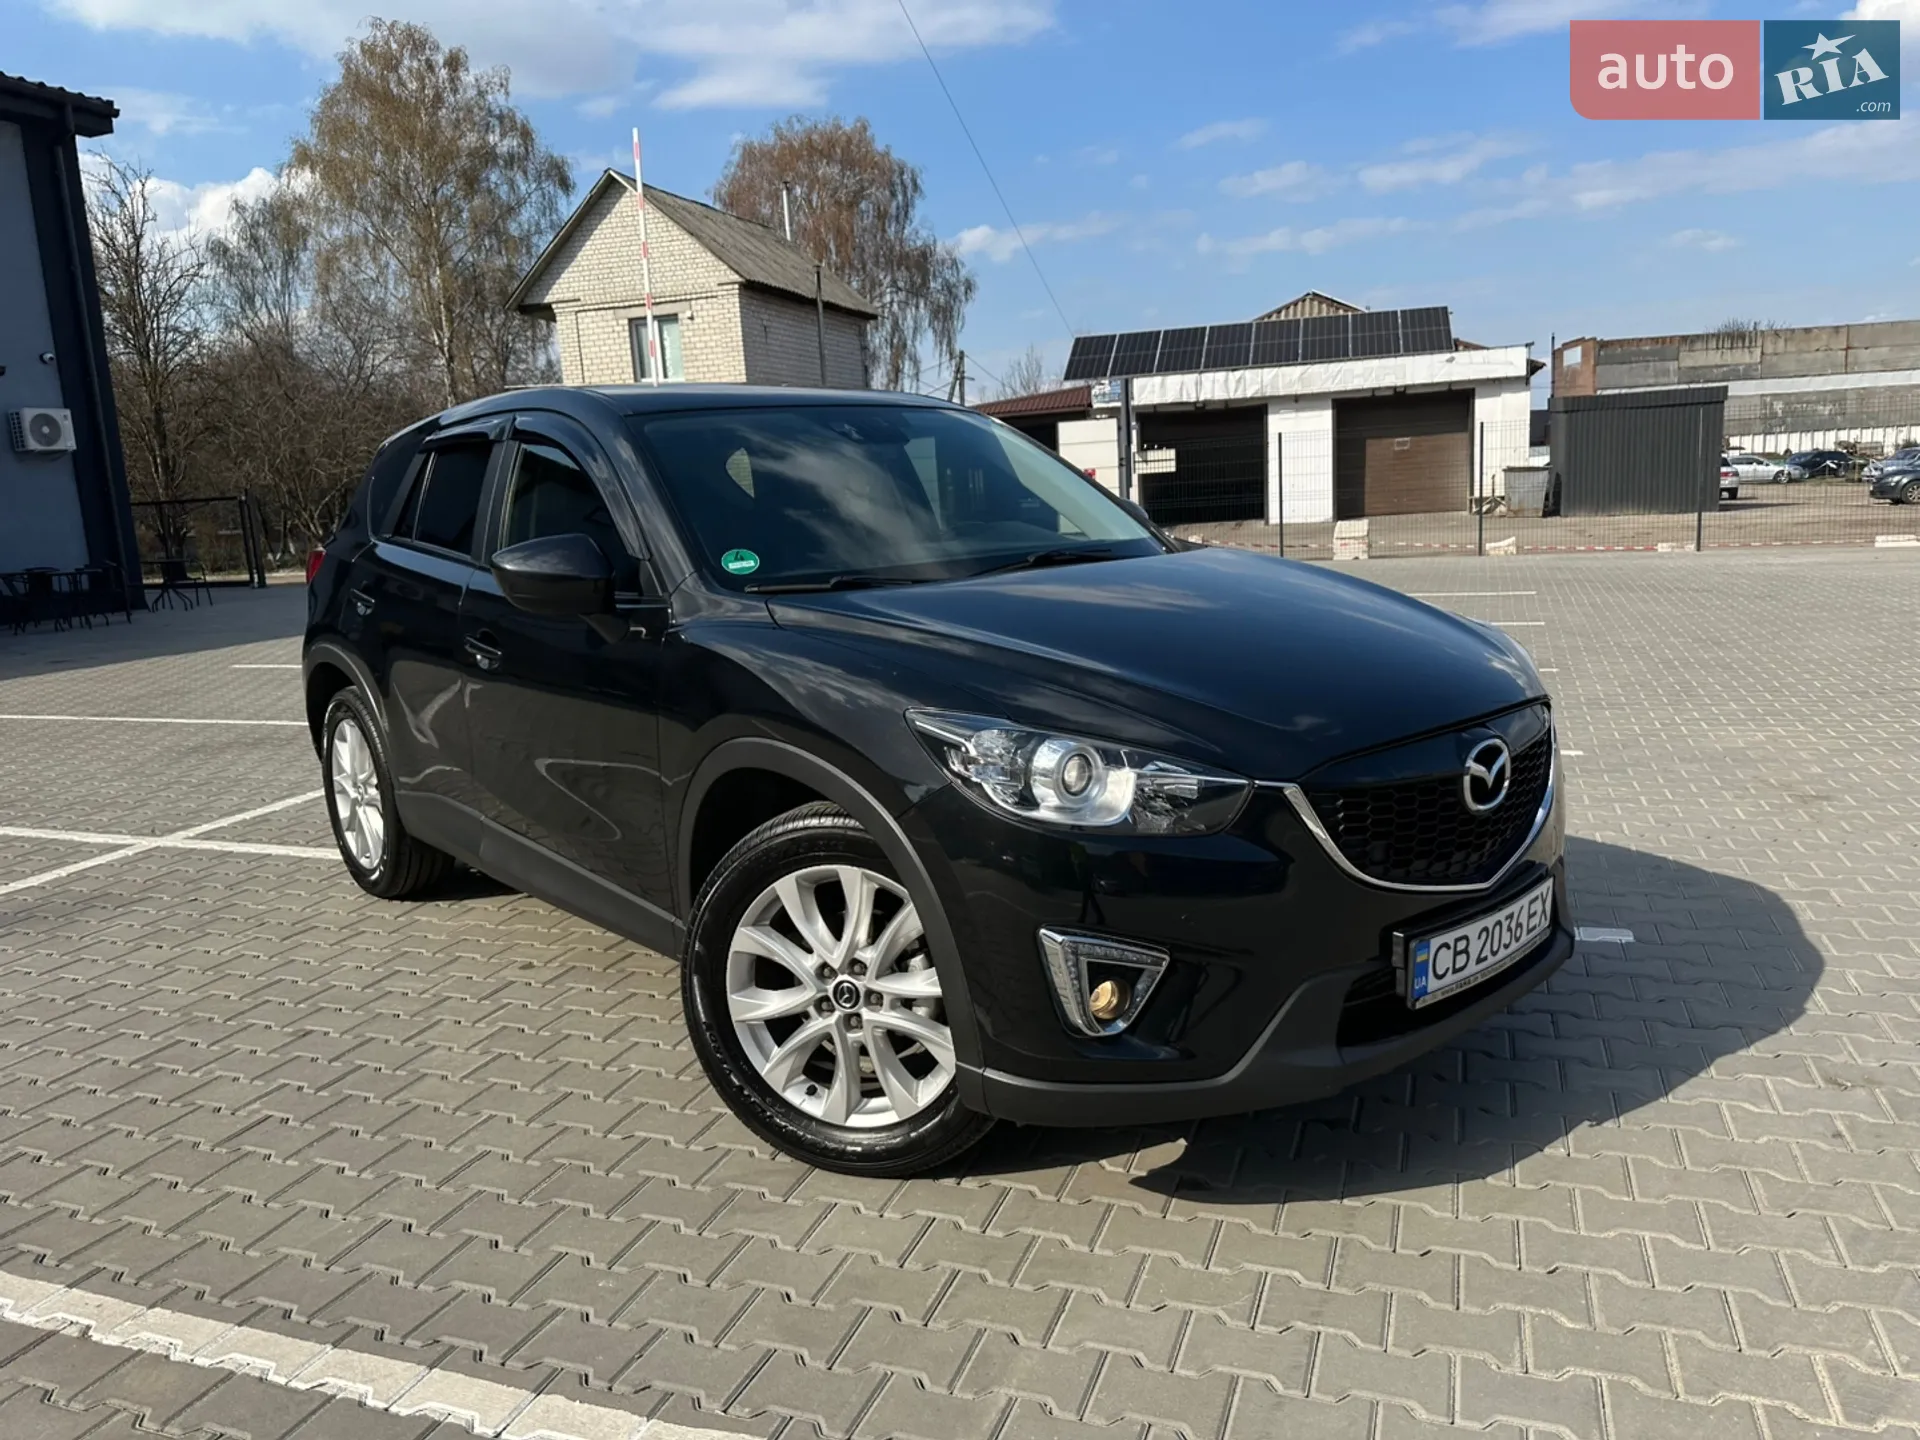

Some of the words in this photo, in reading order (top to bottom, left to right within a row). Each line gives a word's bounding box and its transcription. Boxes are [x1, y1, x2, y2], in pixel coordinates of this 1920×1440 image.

[1432, 934, 1471, 980] CB
[1475, 905, 1524, 966] 2036
[1526, 886, 1551, 937] EX
[1414, 977, 1427, 990] UA
